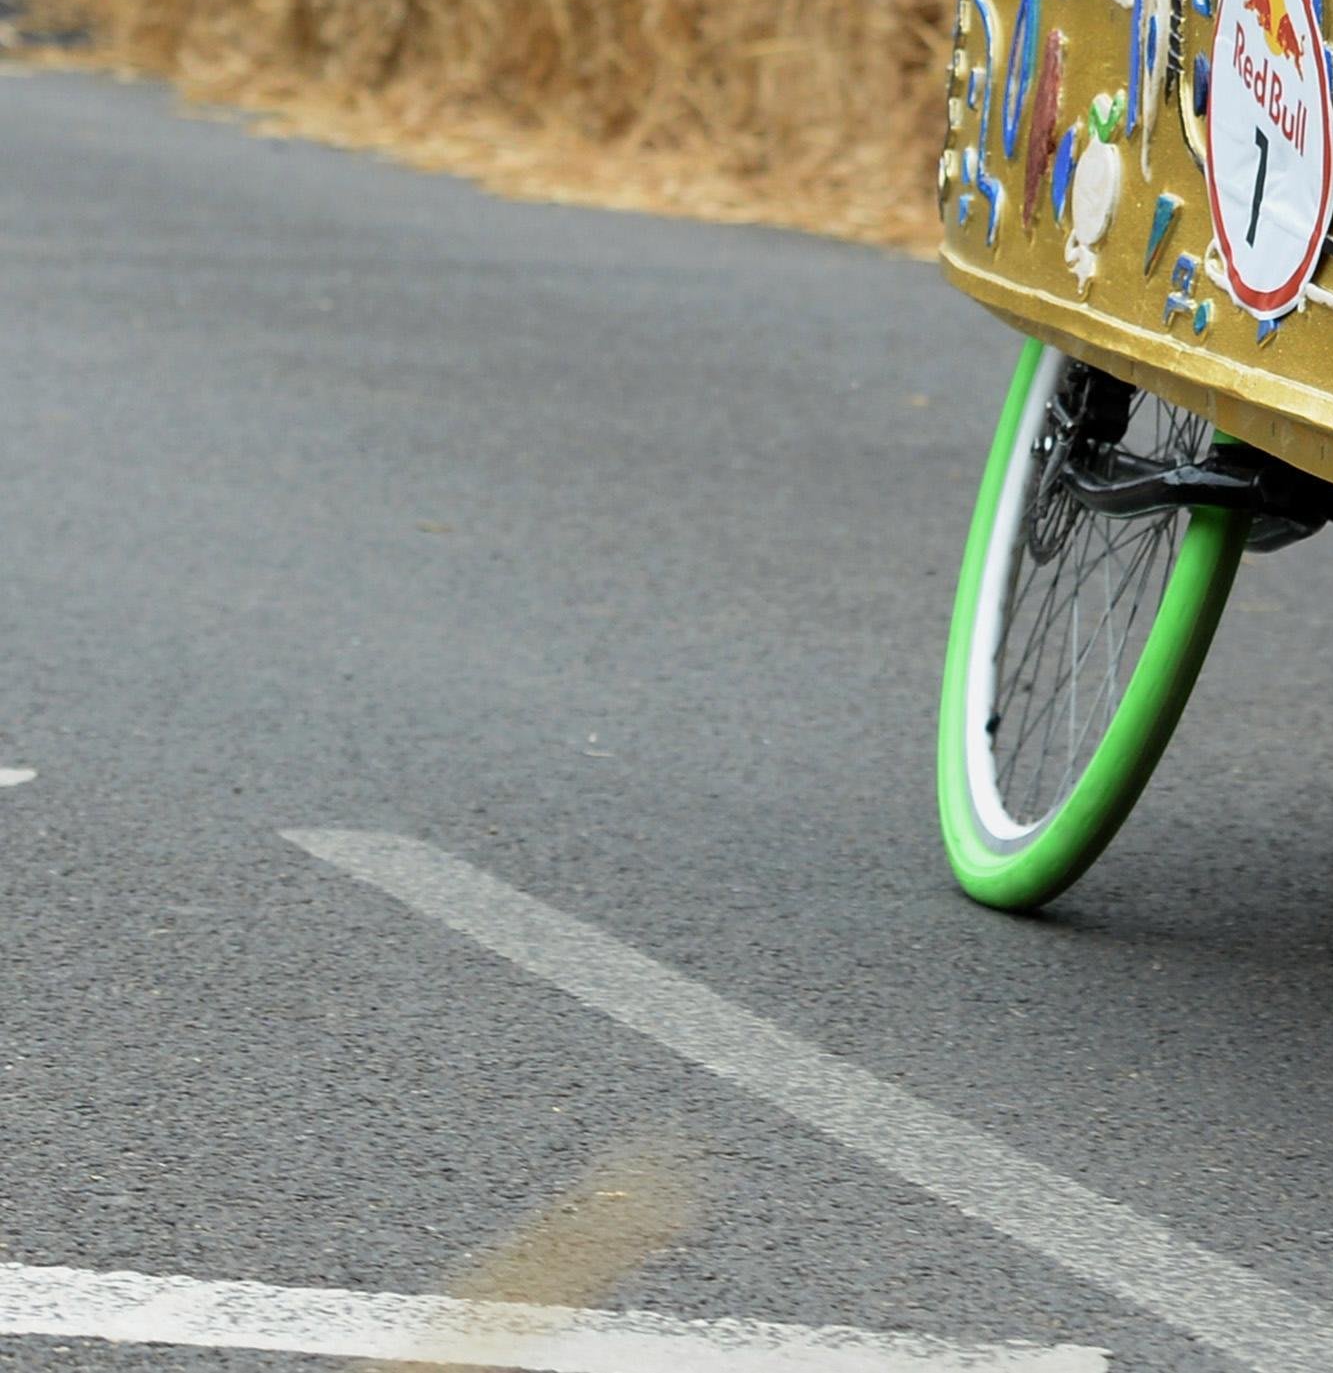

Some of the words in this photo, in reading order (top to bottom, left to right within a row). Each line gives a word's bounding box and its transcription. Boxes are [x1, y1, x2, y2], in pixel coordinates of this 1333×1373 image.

[1233, 20, 1269, 108] Red
[1269, 70, 1308, 157] Bull
[1245, 125, 1269, 249] 1
